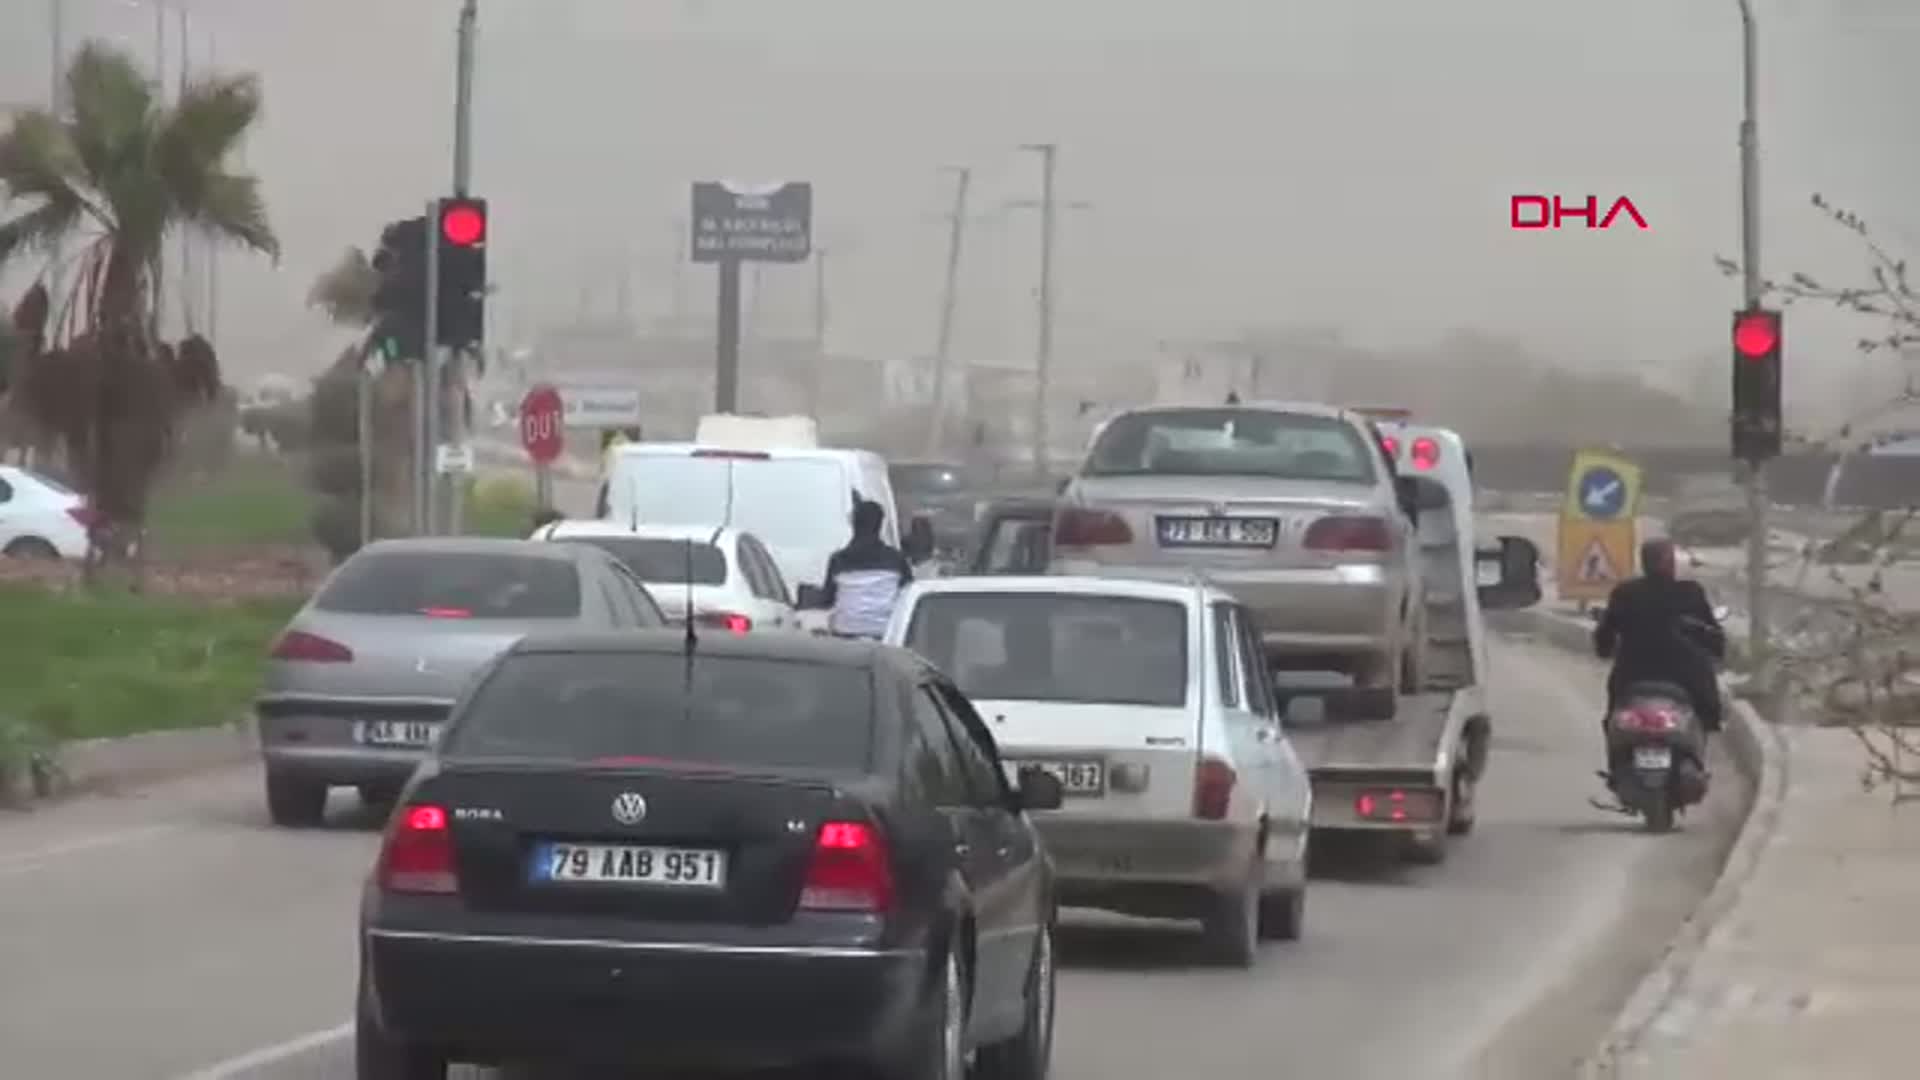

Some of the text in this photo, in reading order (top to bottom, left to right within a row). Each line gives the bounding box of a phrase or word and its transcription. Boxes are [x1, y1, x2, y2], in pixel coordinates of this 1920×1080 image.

[554, 847, 715, 882] 79 AAB 951
